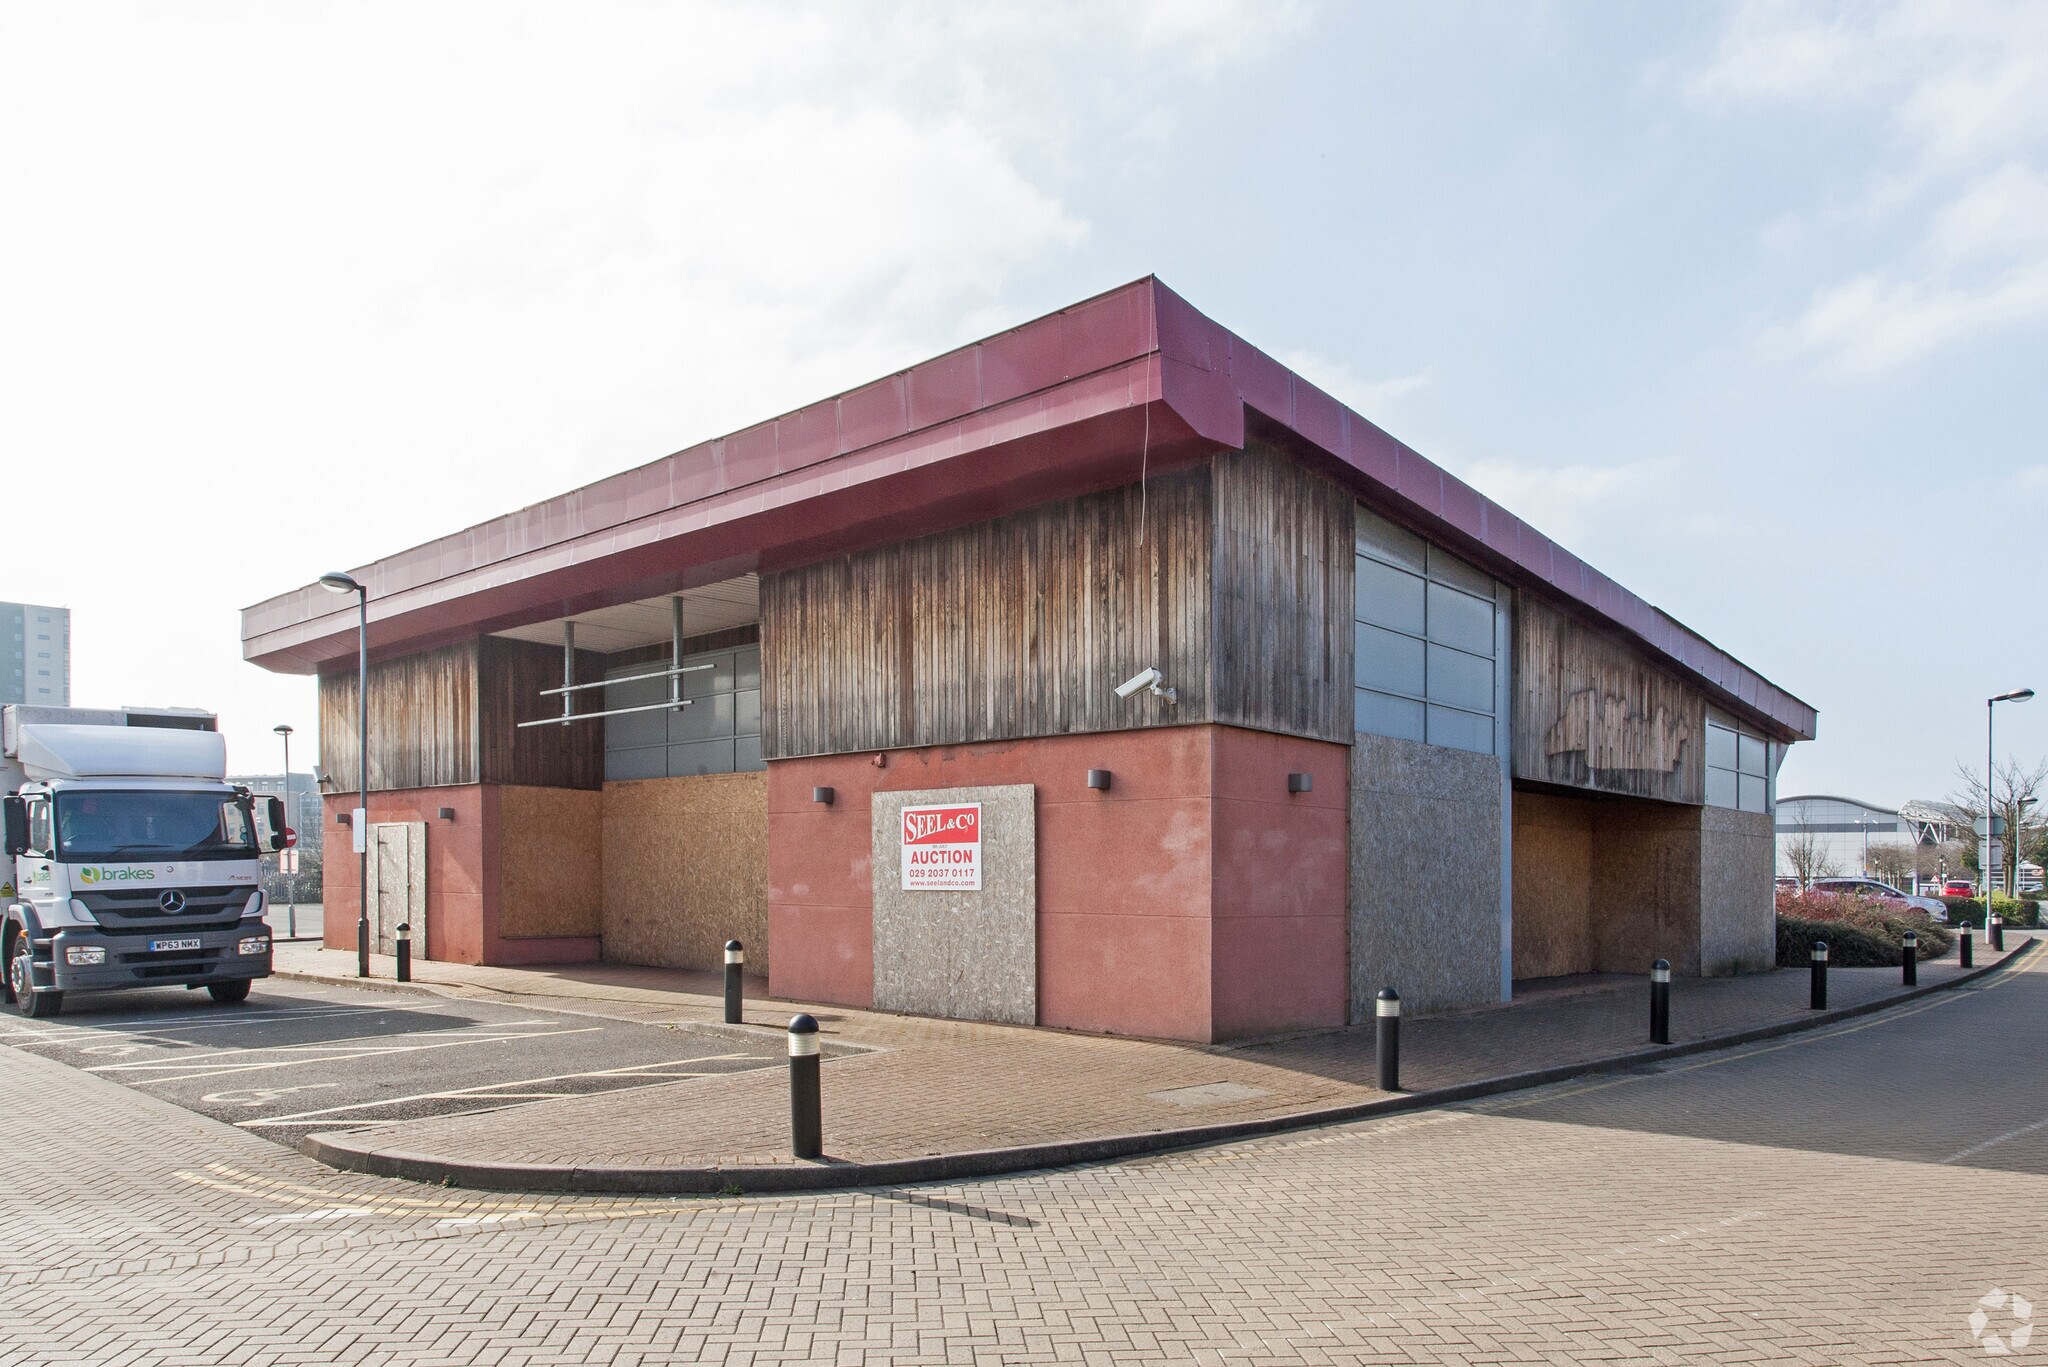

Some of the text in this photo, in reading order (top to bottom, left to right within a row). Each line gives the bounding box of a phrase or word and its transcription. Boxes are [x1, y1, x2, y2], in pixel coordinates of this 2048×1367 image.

[910, 849, 973, 864] AUCTION
[101, 866, 155, 881] brakes
[909, 868, 975, 878] 029 2037 0117
[910, 879, 975, 887] www.seelandco.com
[156, 940, 199, 950] WP63 NMX
